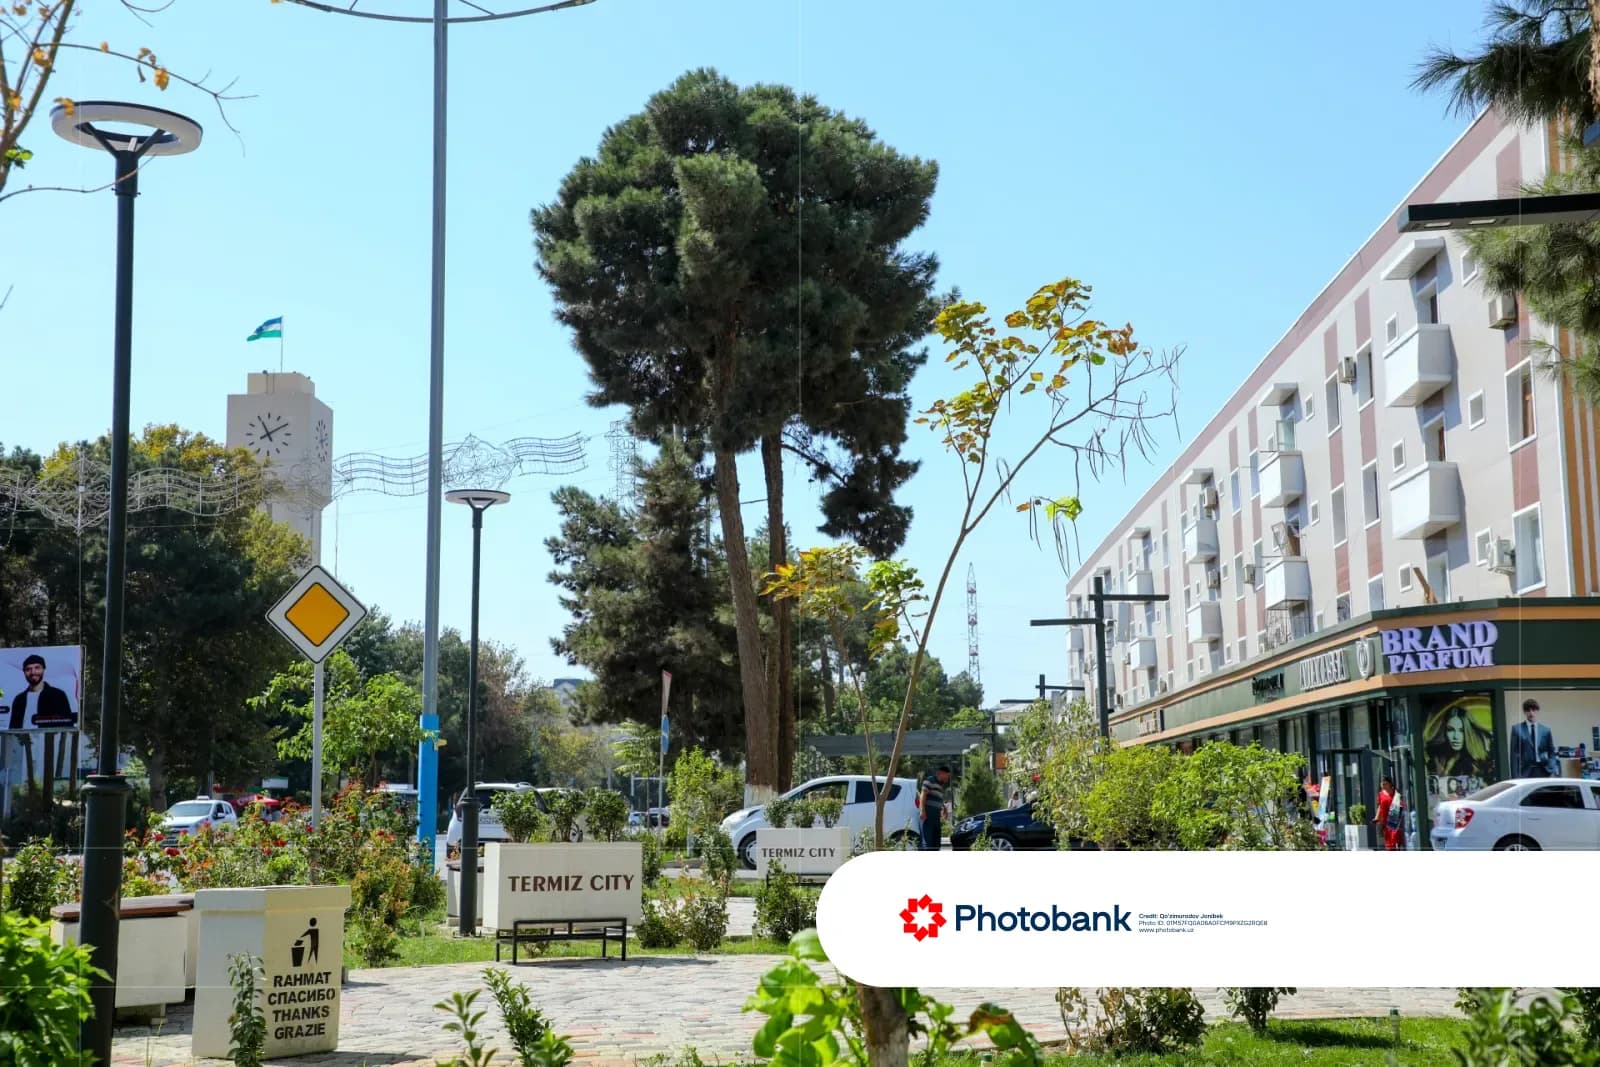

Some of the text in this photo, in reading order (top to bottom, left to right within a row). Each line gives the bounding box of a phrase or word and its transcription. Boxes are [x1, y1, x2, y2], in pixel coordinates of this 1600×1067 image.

[1380, 620, 1499, 655] BRAND
[1387, 646, 1495, 675] PARFUM
[762, 847, 836, 858] TERMIZ CITY
[507, 874, 634, 892] TERMIZ CITY
[273, 971, 332, 988] RAHMAT
[267, 988, 336, 1006] СПАСИБО
[272, 1005, 330, 1023] THANKS
[274, 1023, 326, 1040] GRAZIE
